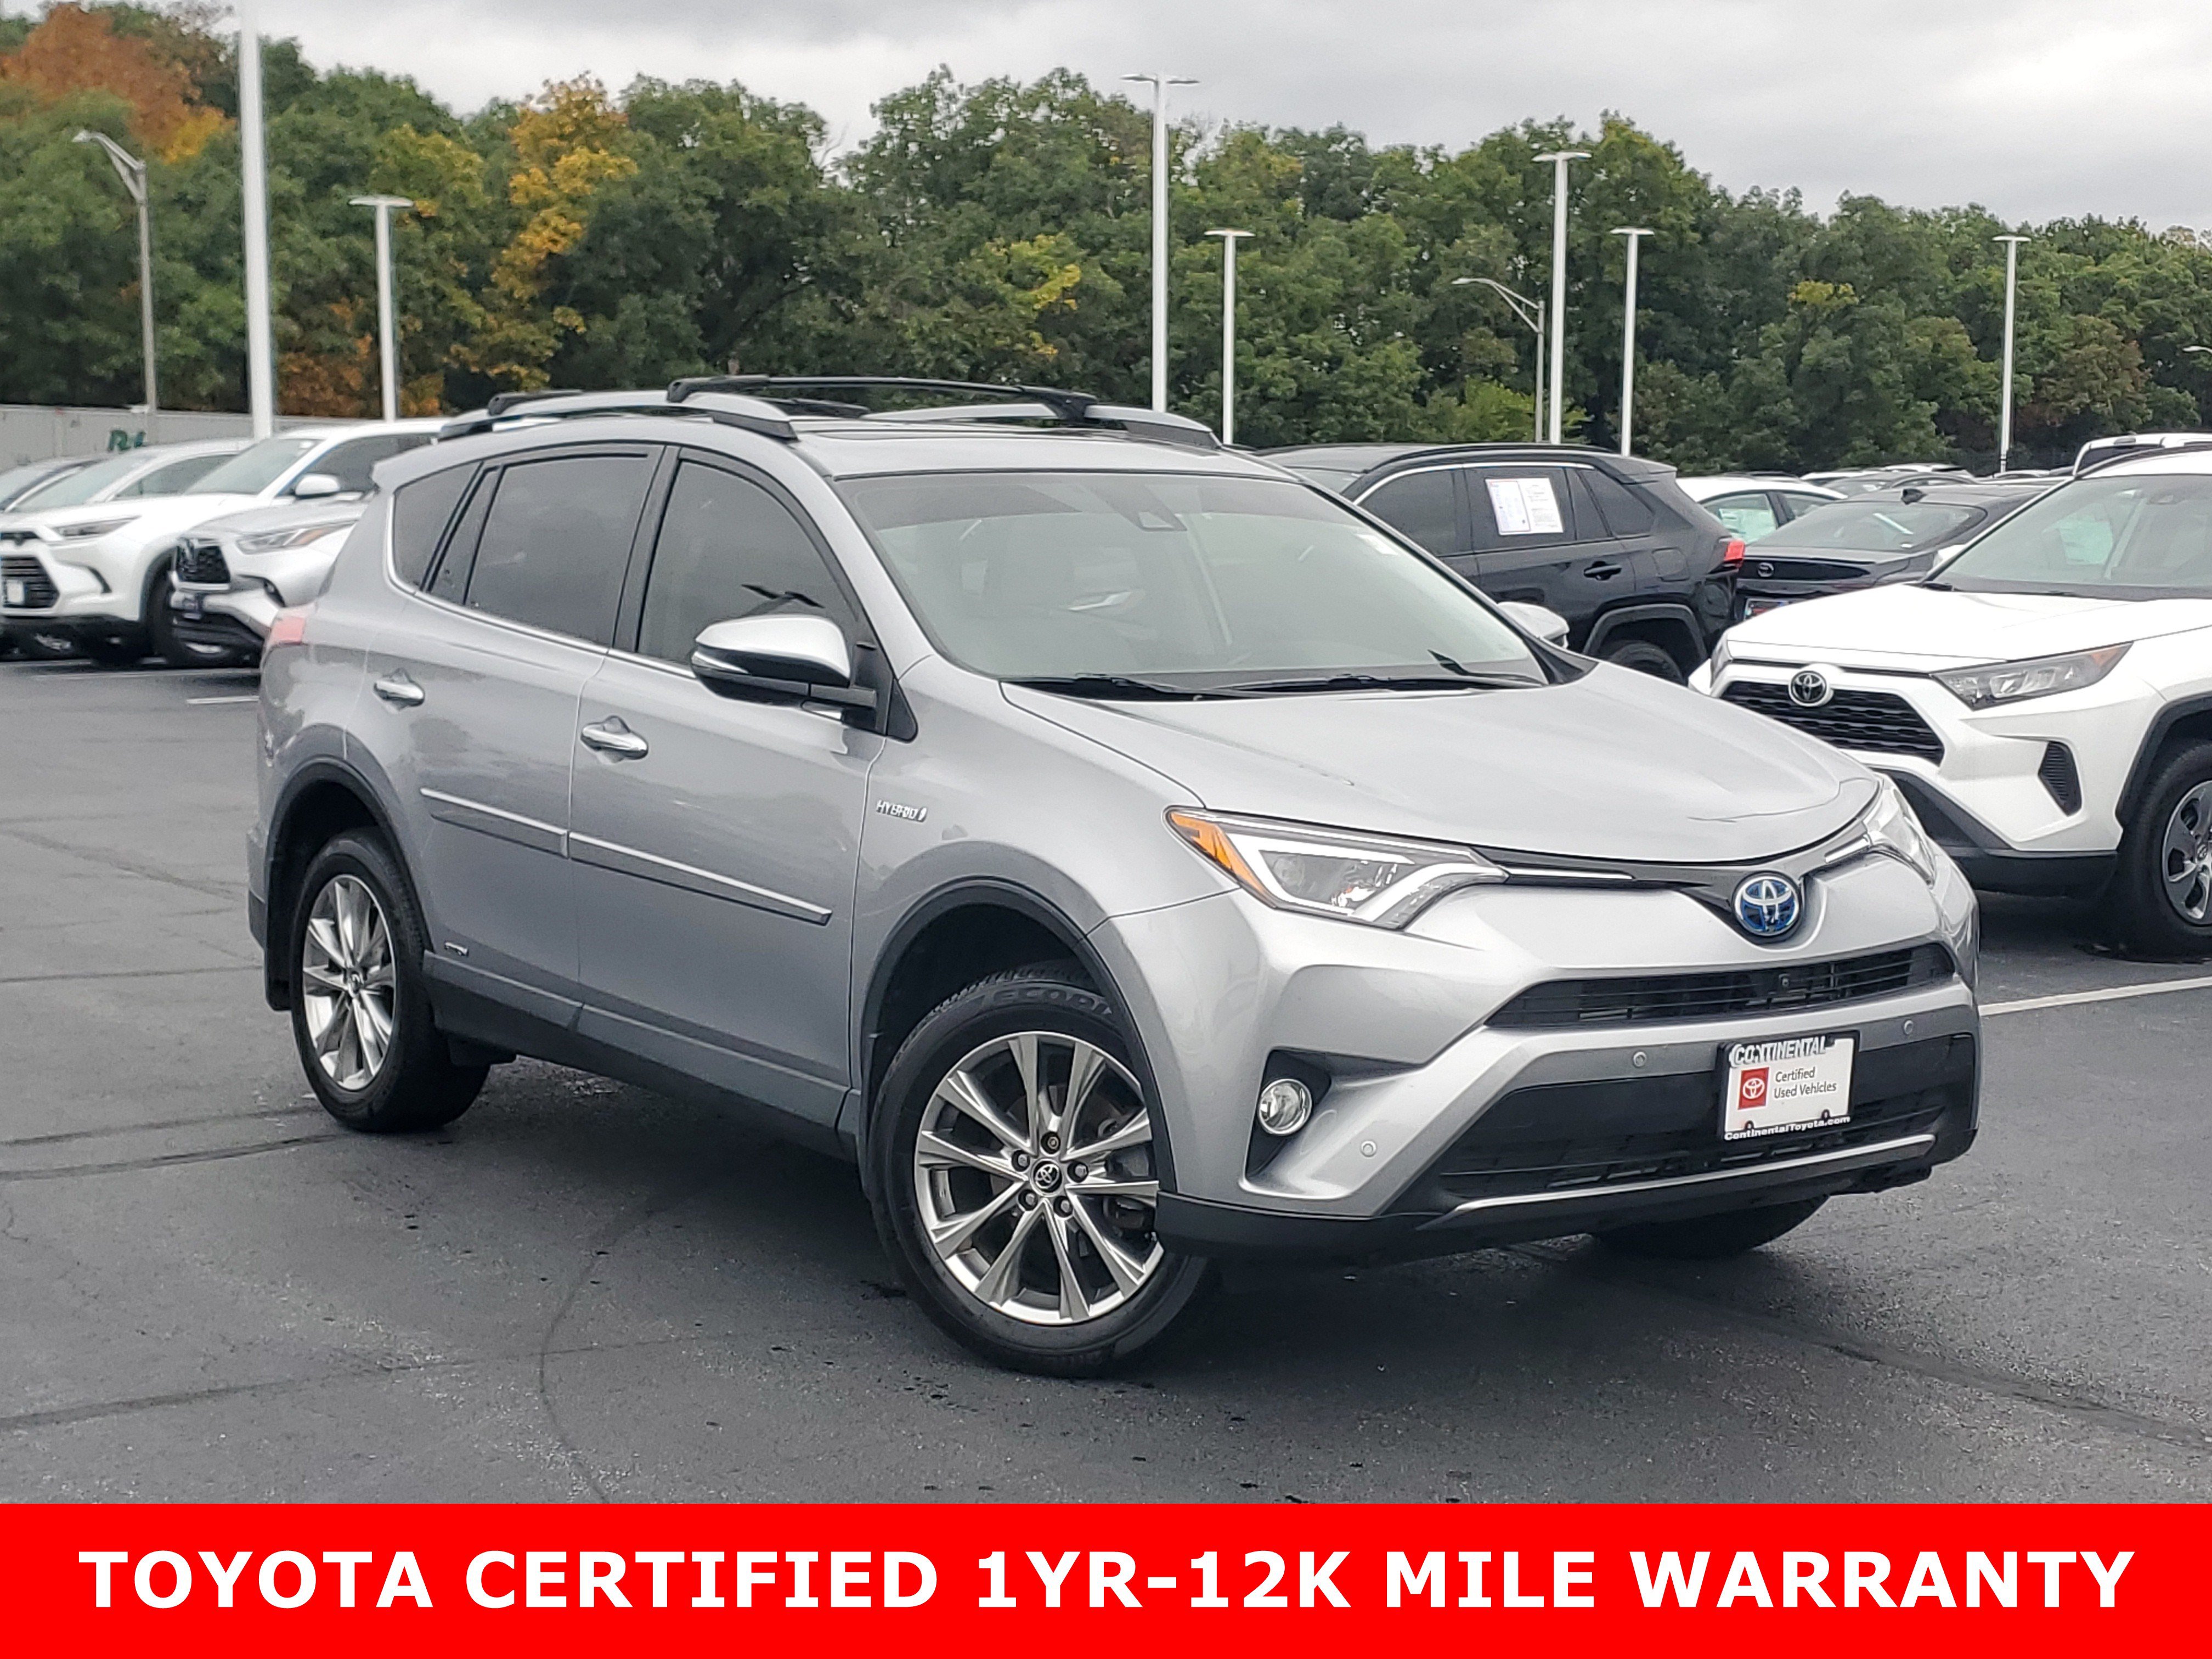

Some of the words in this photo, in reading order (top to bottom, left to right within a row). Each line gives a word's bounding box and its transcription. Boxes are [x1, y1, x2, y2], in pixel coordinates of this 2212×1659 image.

[876, 800, 918, 821] HYBRID
[993, 986, 1114, 1016] ECOPI
[1730, 1036, 1826, 1065] CONTINENTAL
[1775, 1066, 1816, 1083] Certified
[1774, 1084, 1797, 1099] Used
[1799, 1081, 1837, 1096] Vehicles
[1724, 1116, 1851, 1141] ContinentalToyota.com
